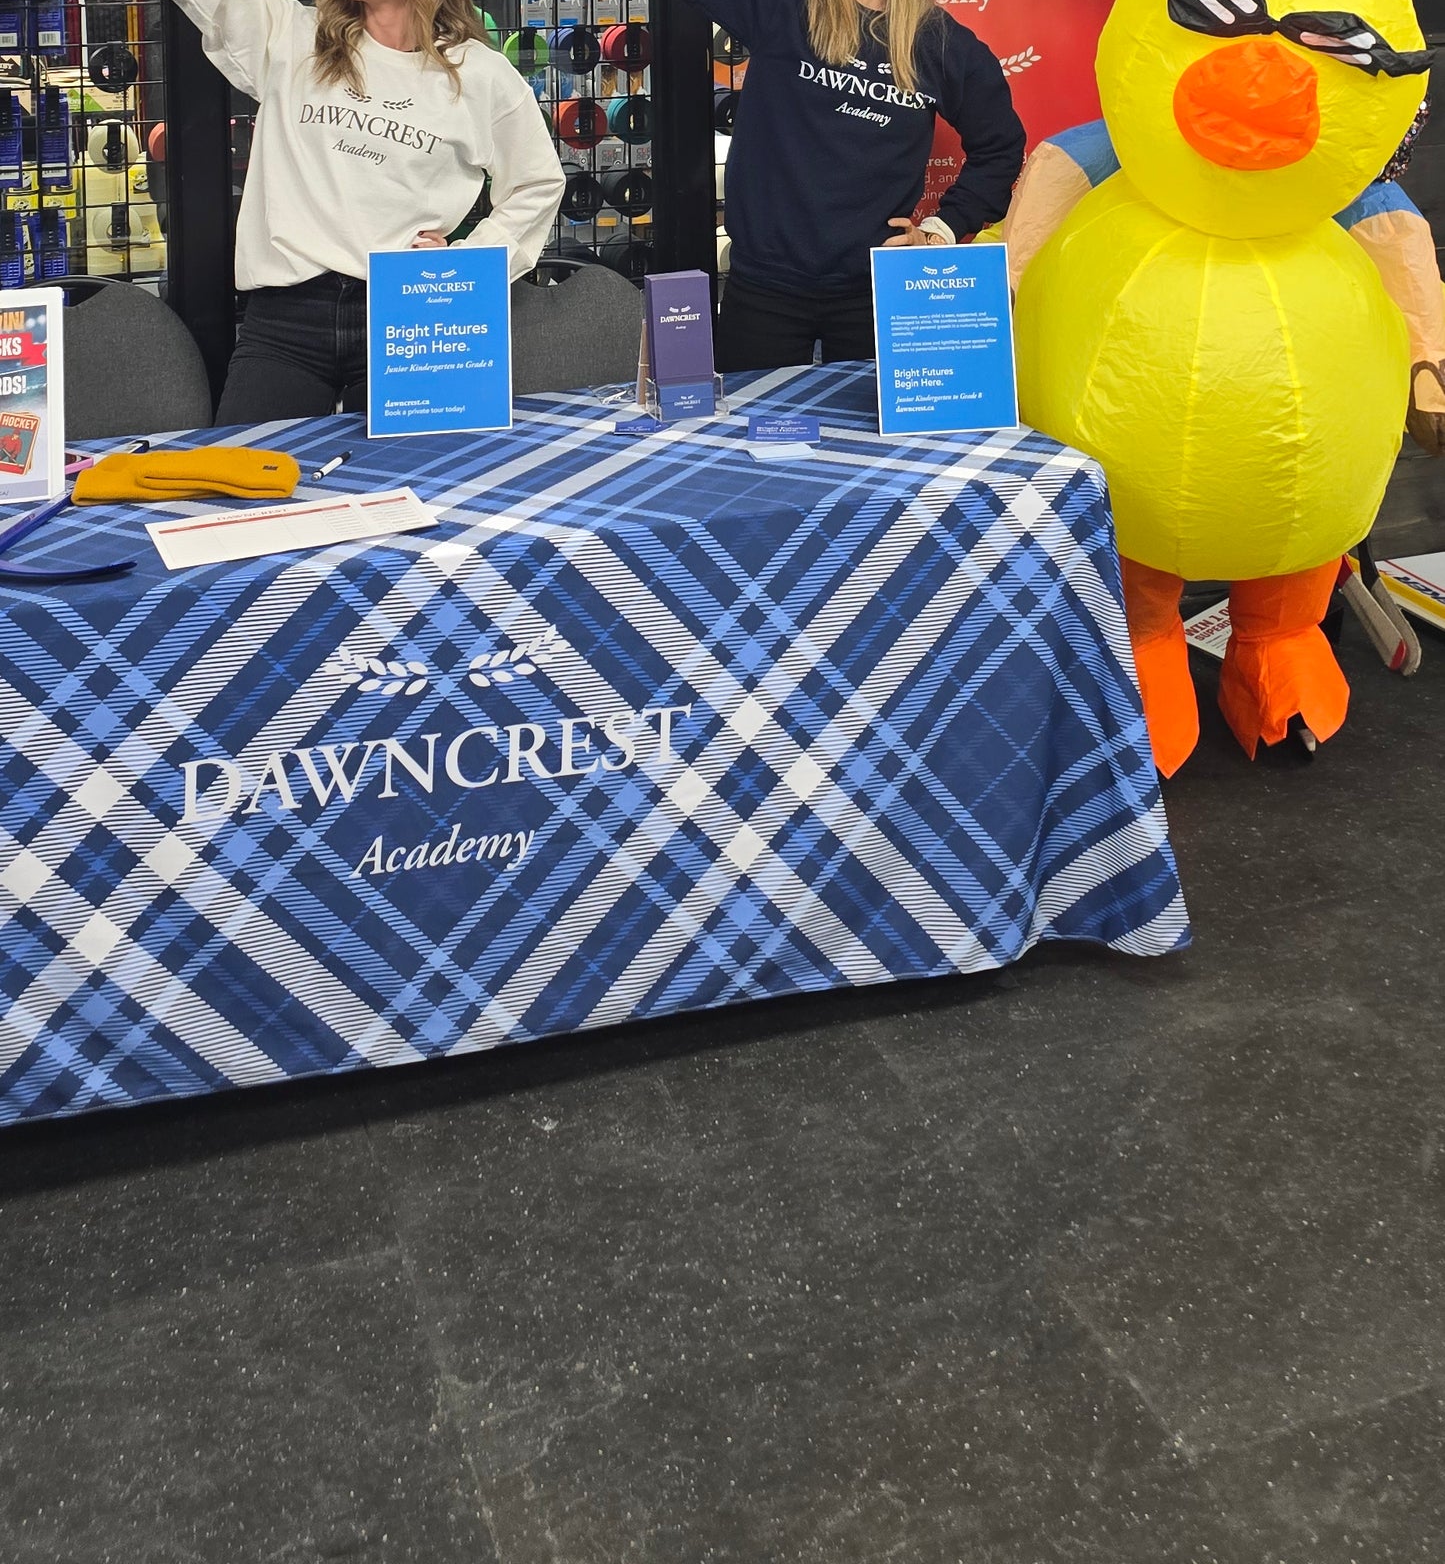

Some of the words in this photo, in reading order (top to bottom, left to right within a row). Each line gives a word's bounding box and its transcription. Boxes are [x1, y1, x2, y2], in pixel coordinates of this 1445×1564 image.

[835, 101, 892, 127] Academy
[299, 104, 443, 154] DAWNCREST
[332, 139, 388, 166] Academy
[926, 156, 958, 168] rest,
[402, 281, 475, 294] DAWNCREST
[905, 277, 976, 290] DAWNCREST
[386, 324, 430, 341] Bright
[435, 323, 488, 336] Futures
[386, 341, 427, 358] Begin
[431, 340, 471, 353] Here.
[384, 365, 409, 375] Junior
[410, 363, 455, 372] Kindergarten
[465, 359, 487, 368] Grade
[488, 359, 494, 367] 8
[894, 369, 919, 380] Bright
[922, 367, 954, 376] Futures
[894, 379, 918, 390] Begin
[921, 378, 944, 387] Here.
[384, 399, 430, 407] dawncrest.ca
[408, 408, 429, 417] private
[2, 415, 37, 430] HOCKEY
[177, 703, 693, 826] DAWNCREST
[350, 824, 535, 878] Academy
